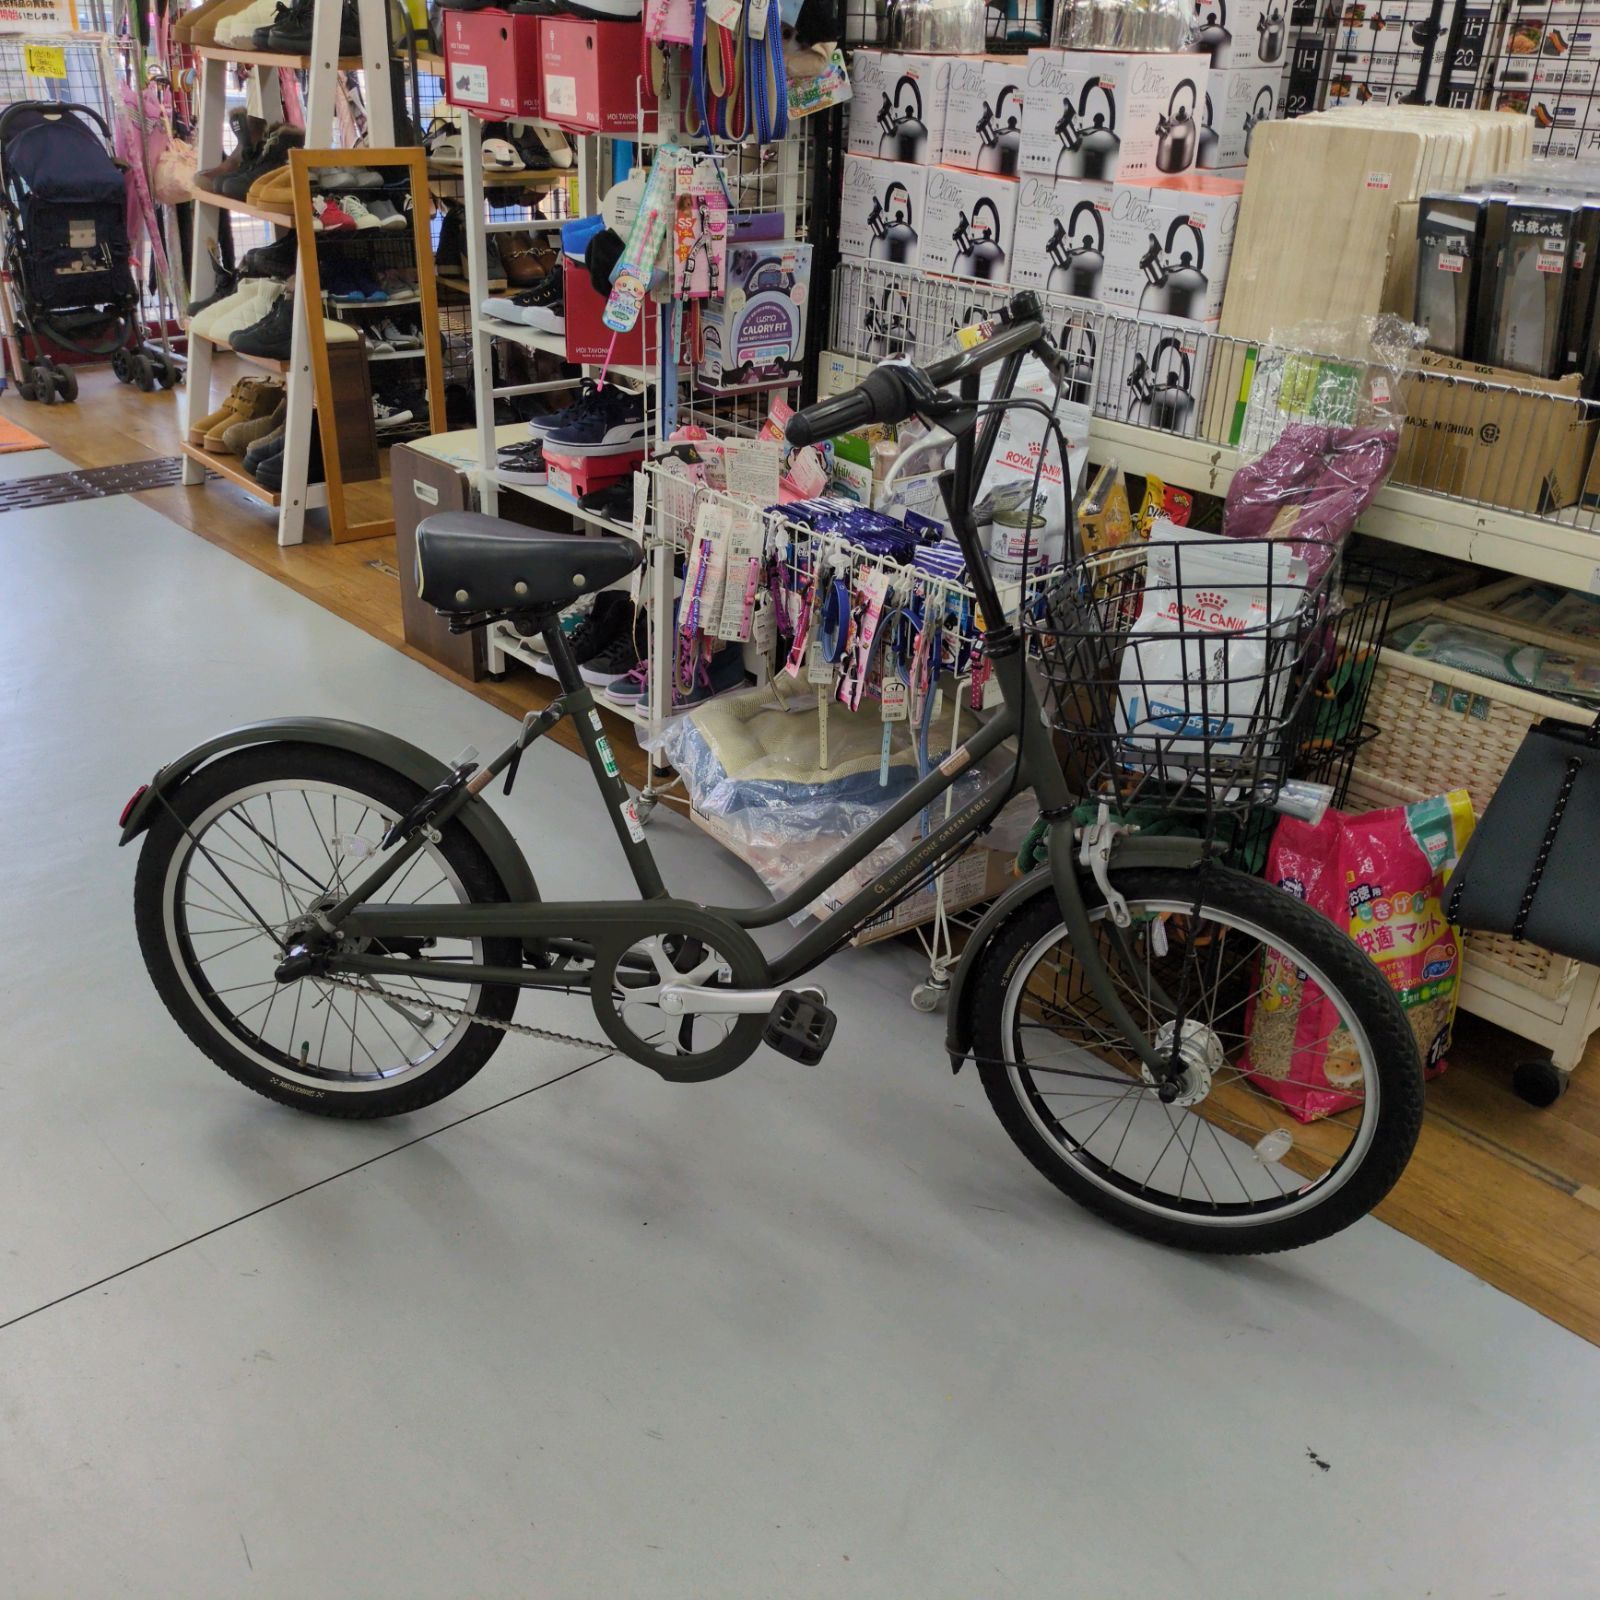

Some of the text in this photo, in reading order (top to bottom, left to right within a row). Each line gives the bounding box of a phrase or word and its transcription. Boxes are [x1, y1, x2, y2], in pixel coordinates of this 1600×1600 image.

[1112, 190, 1153, 221] Clair
[1511, 219, 1563, 238] 伝統の技
[742, 322, 788, 336] CALORY FIT
[1006, 450, 1034, 470] ROYAL
[1168, 601, 1248, 631] ROYAL CANIN
[890, 841, 938, 885] BRIDGESTONE
[939, 818, 965, 841] GREEN
[966, 798, 990, 821] LABEL
[1355, 914, 1441, 955] 快適マット
